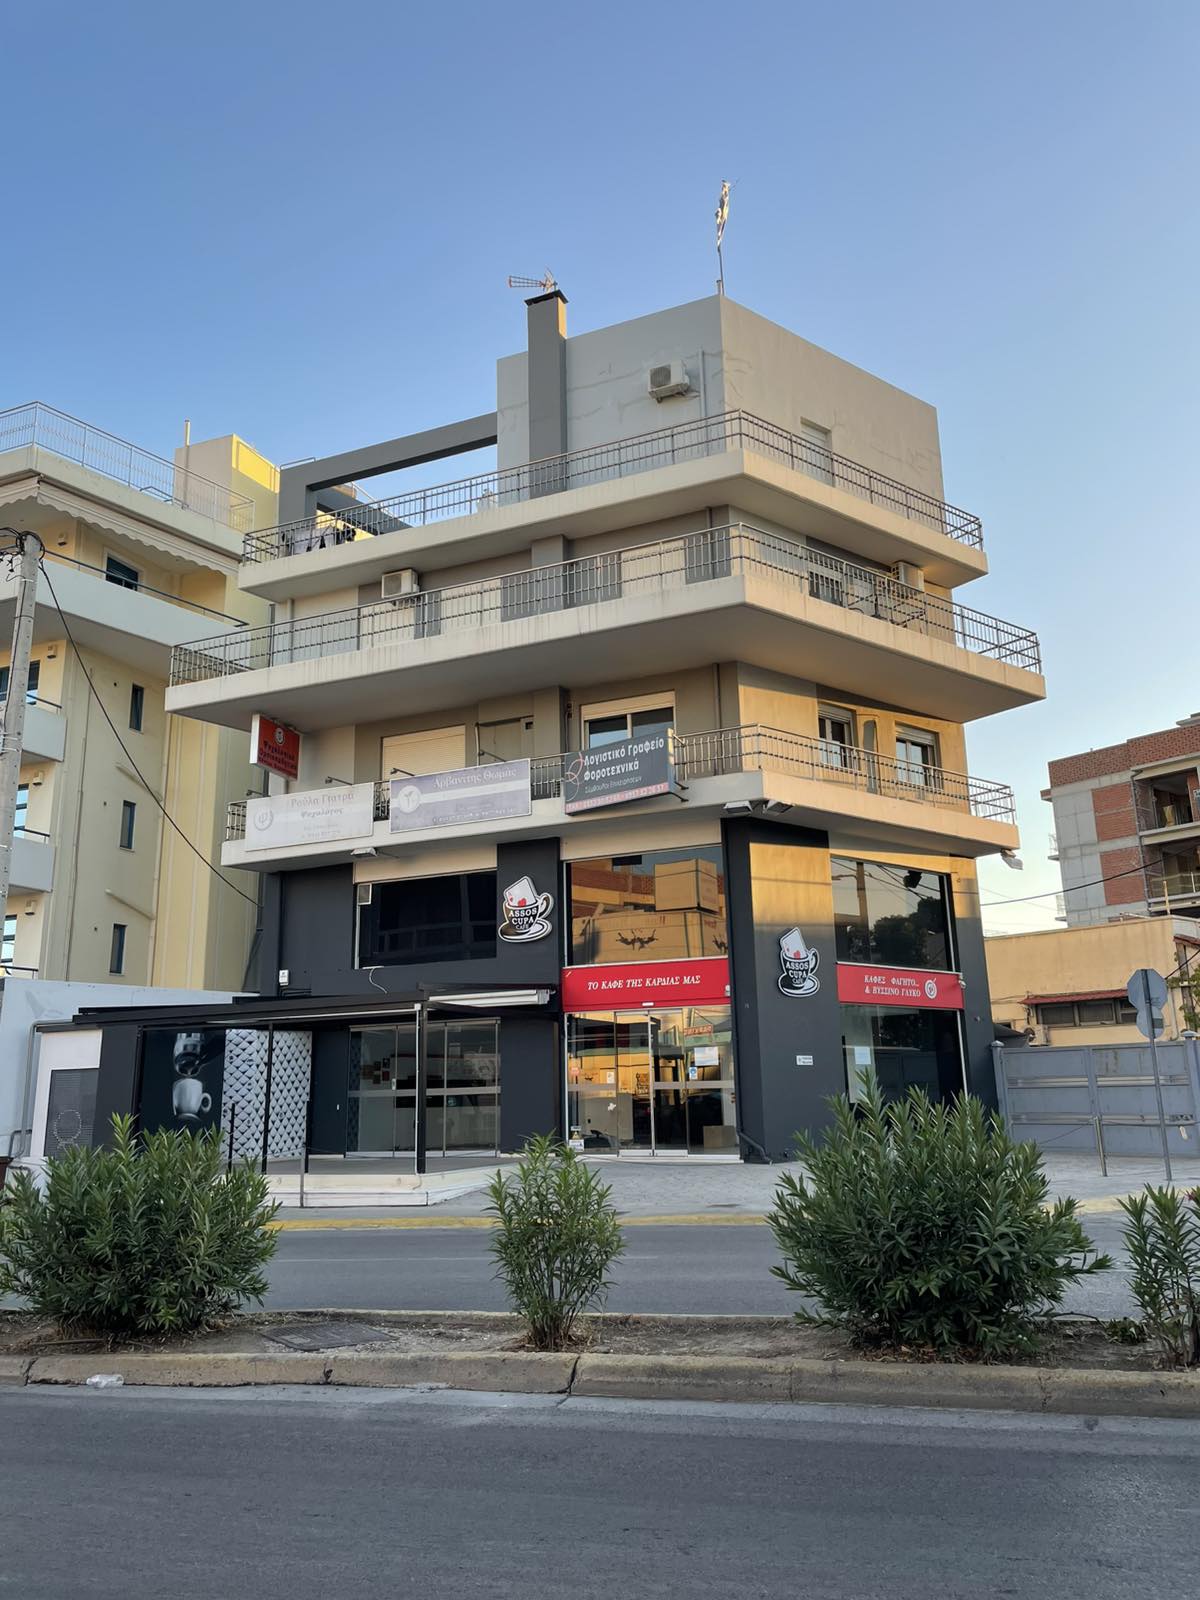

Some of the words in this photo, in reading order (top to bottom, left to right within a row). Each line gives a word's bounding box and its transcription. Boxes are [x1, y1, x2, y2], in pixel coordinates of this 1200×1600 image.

[584, 745, 626, 766] Λογιστικό
[627, 737, 665, 756] Γραφείο
[583, 758, 640, 781] Φοροτεχνικά
[508, 907, 537, 918] ASSOS
[511, 916, 534, 925] CUPA
[786, 961, 809, 970] ASSOS
[789, 970, 807, 978] CUPA
[864, 975, 886, 984] ΚΑΦΕΣ
[587, 982, 599, 990] ΤΟ
[601, 979, 624, 989] ΚΑΦΕ
[626, 979, 643, 988] ΤΗΣ
[645, 976, 680, 986] ΚΑΡΔΙΑΣ
[682, 975, 701, 984] ΜΑΣ
[865, 985, 871, 994] &
[901, 988, 921, 997] ΓΛΥΚΟ
